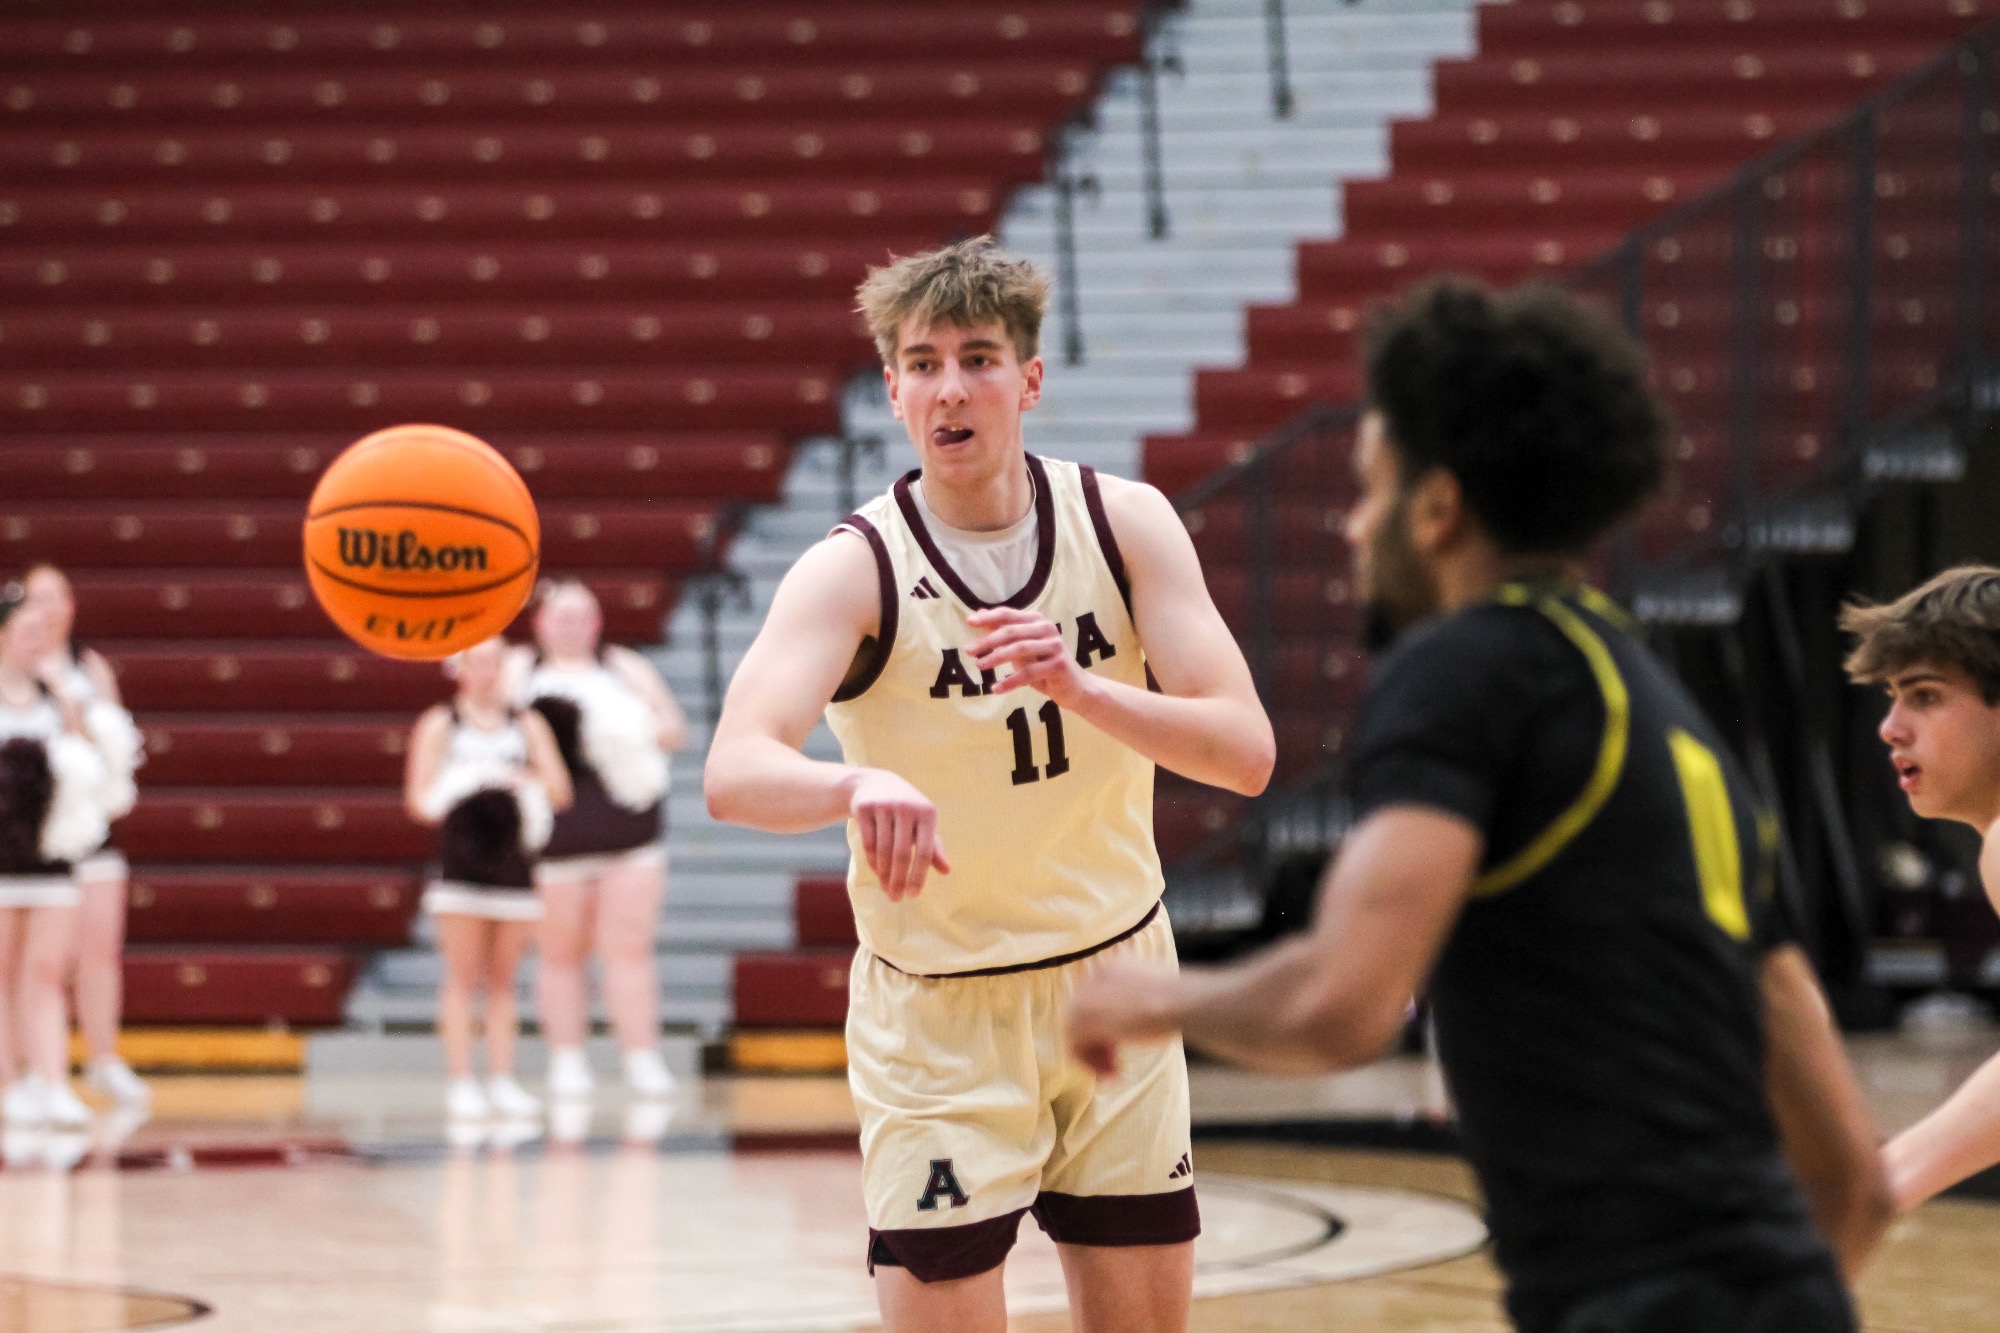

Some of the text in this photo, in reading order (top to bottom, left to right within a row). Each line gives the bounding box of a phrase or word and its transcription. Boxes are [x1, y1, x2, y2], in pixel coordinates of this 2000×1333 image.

[338, 527, 488, 571] Wilson
[930, 611, 1116, 698] AA
[1006, 700, 1069, 785] 11
[917, 1158, 970, 1211] A
